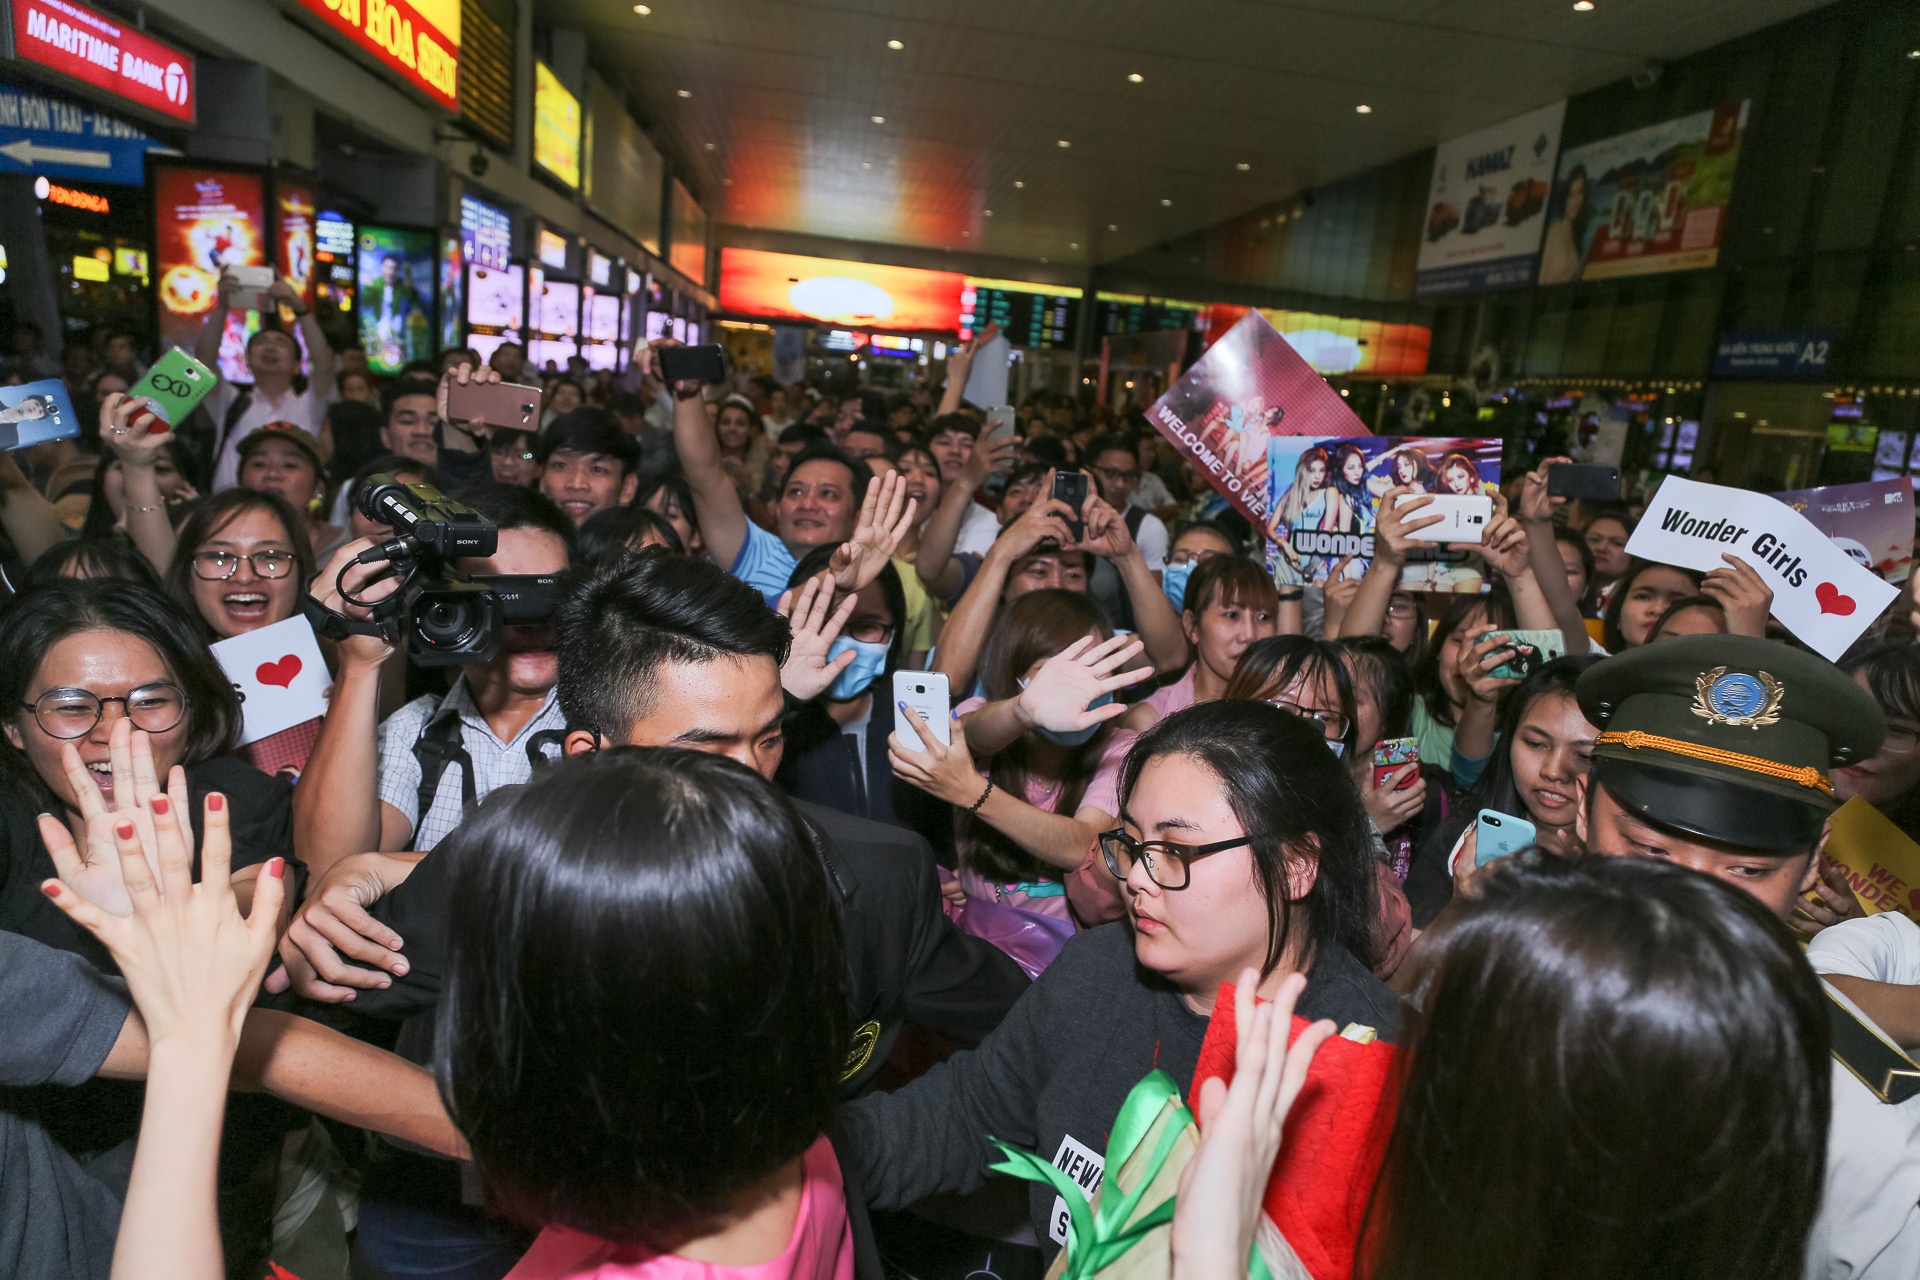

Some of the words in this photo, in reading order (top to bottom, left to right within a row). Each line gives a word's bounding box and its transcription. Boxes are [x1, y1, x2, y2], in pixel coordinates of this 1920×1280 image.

[27, 8, 119, 72] MARITIME
[121, 51, 165, 91] BANK
[365, 0, 416, 69] HOA
[417, 31, 457, 98] SEN
[1799, 340, 1829, 364] A2
[1158, 405, 1224, 475] WELCOME
[1221, 469, 1242, 493] TO
[1296, 532, 1376, 557] WONDE
[1661, 507, 1749, 544] Wonder
[1751, 533, 1808, 588] Girls
[1867, 862, 1909, 897] WE
